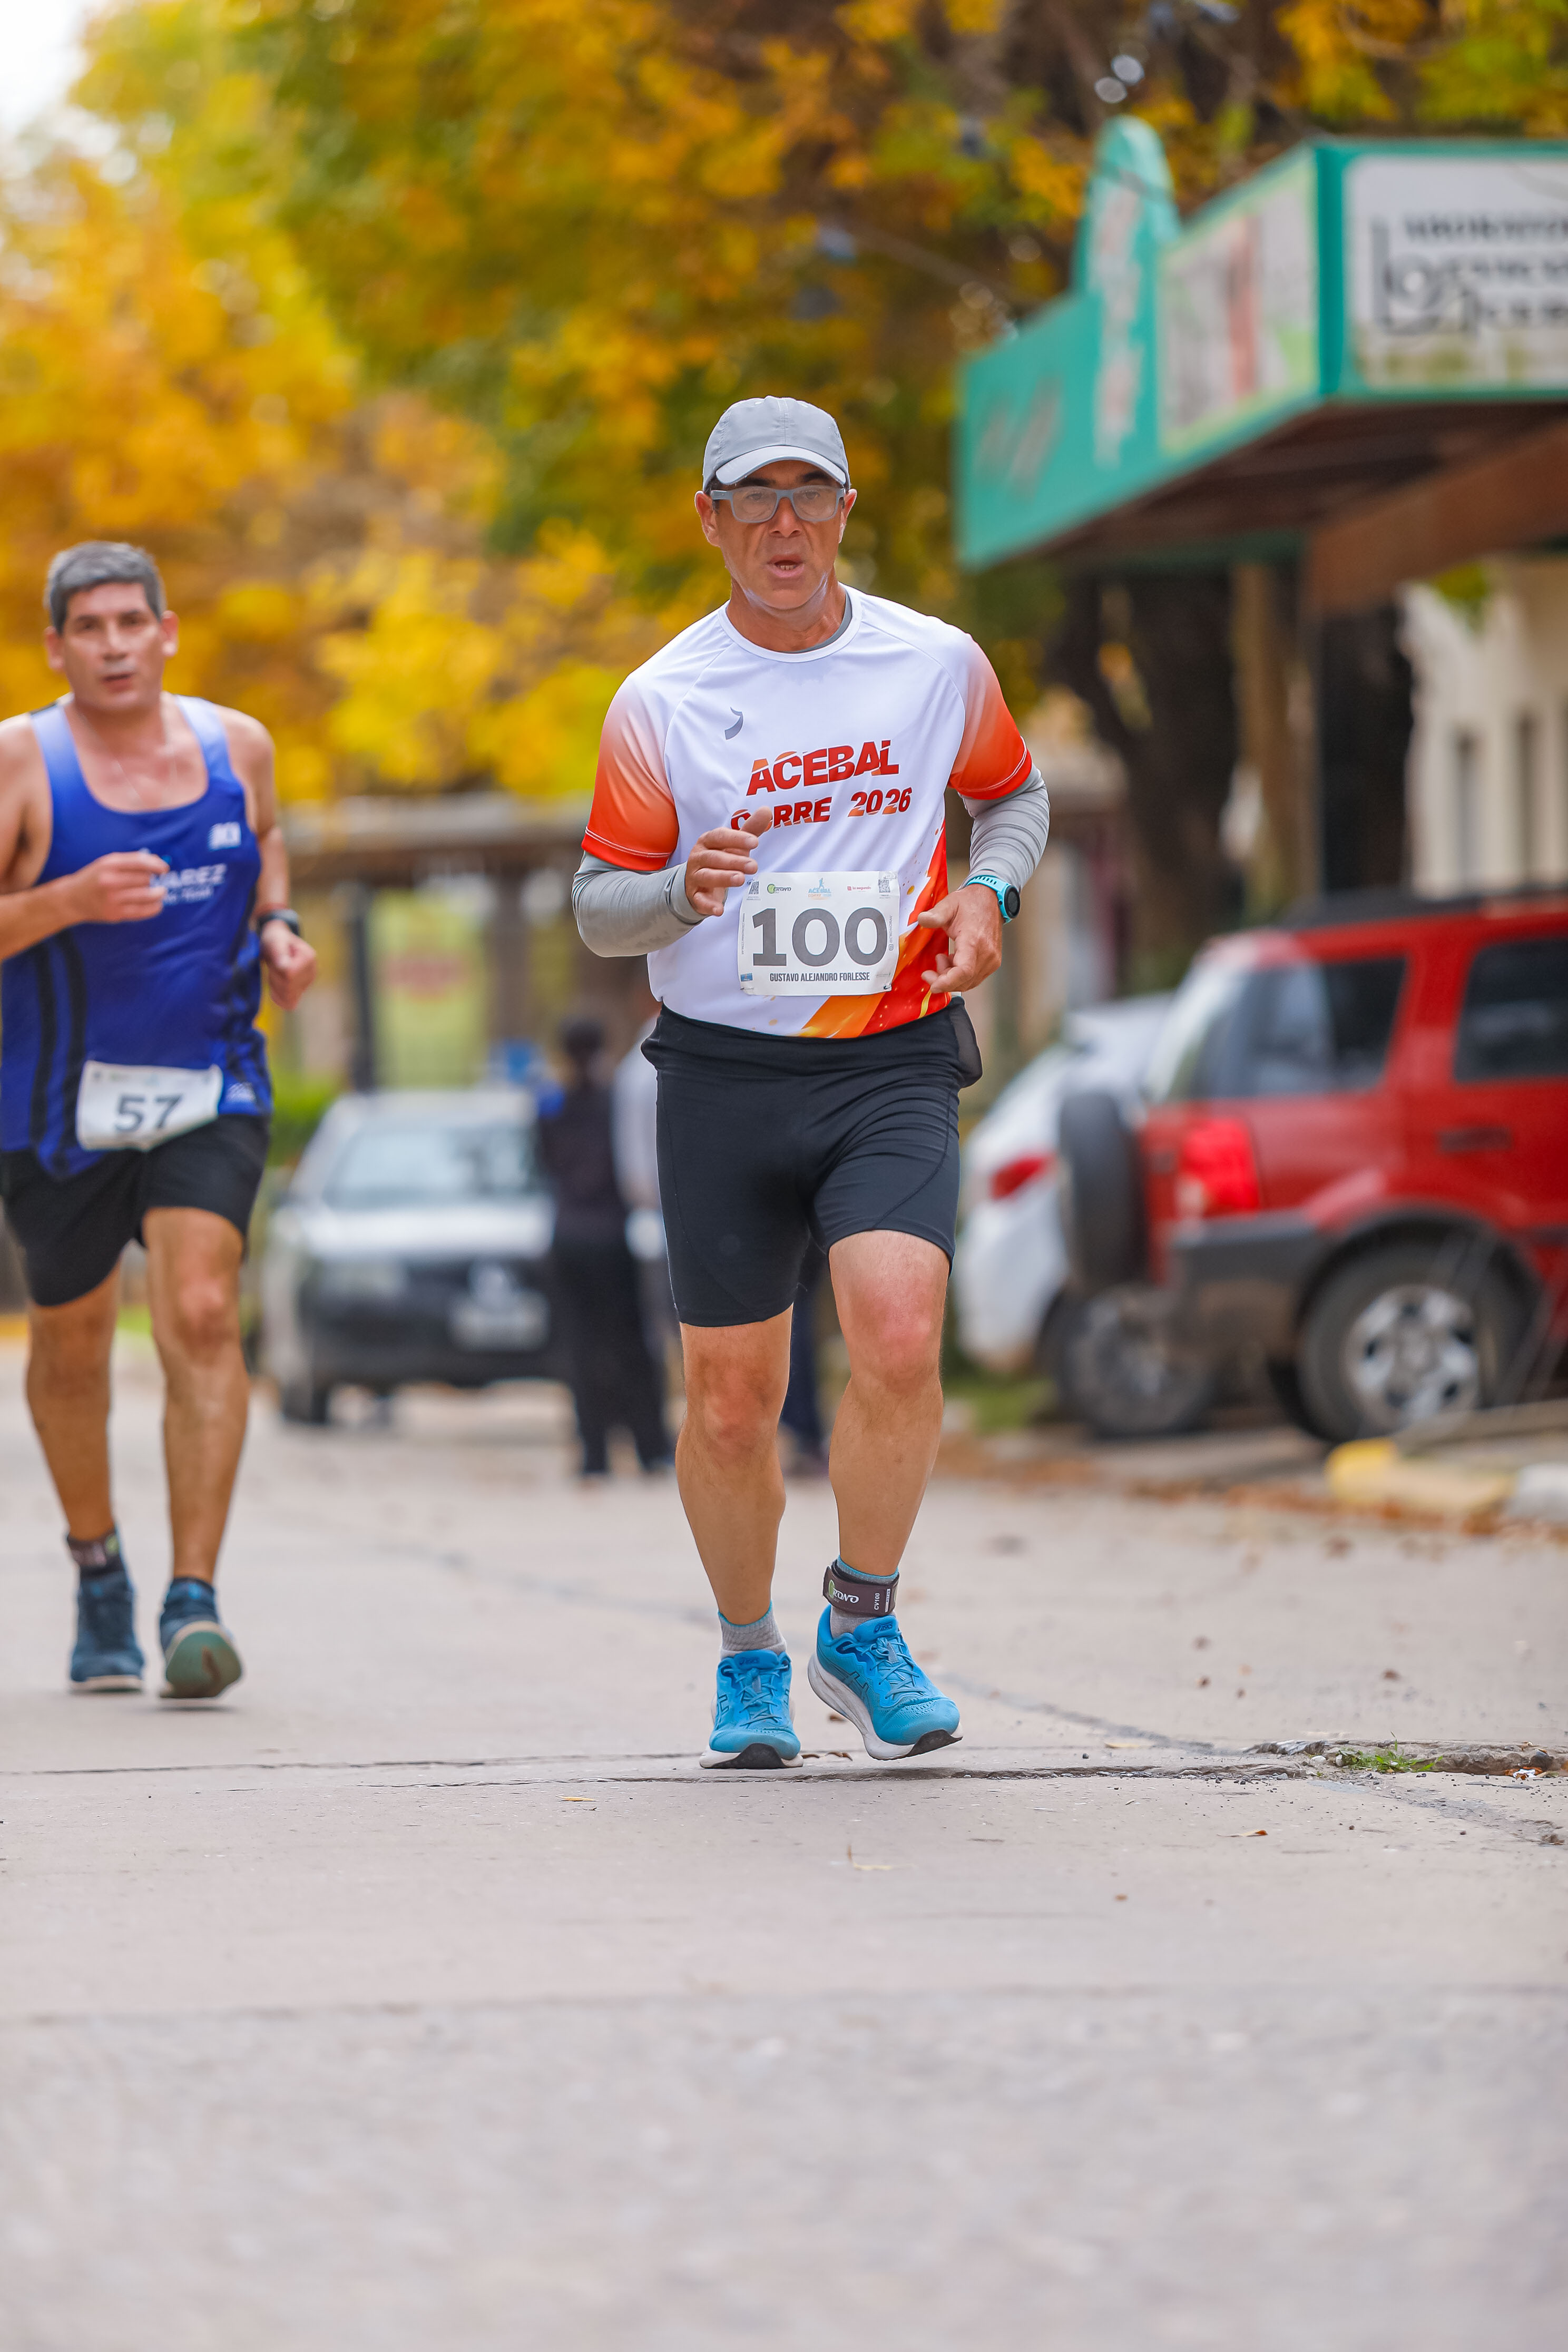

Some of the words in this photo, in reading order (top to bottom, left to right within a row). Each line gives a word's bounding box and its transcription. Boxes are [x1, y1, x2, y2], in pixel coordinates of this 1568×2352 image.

[746, 739, 899, 796] ACEBAL
[731, 797, 832, 831] CRRE
[847, 787, 912, 817] 2026
[150, 863, 227, 888] AREZ
[752, 907, 888, 967] 100
[770, 973, 799, 982] GUSTAVO
[800, 973, 838, 982] ALEJANDRO
[839, 972, 870, 981] FORLESSE
[114, 1093, 183, 1132] 57
